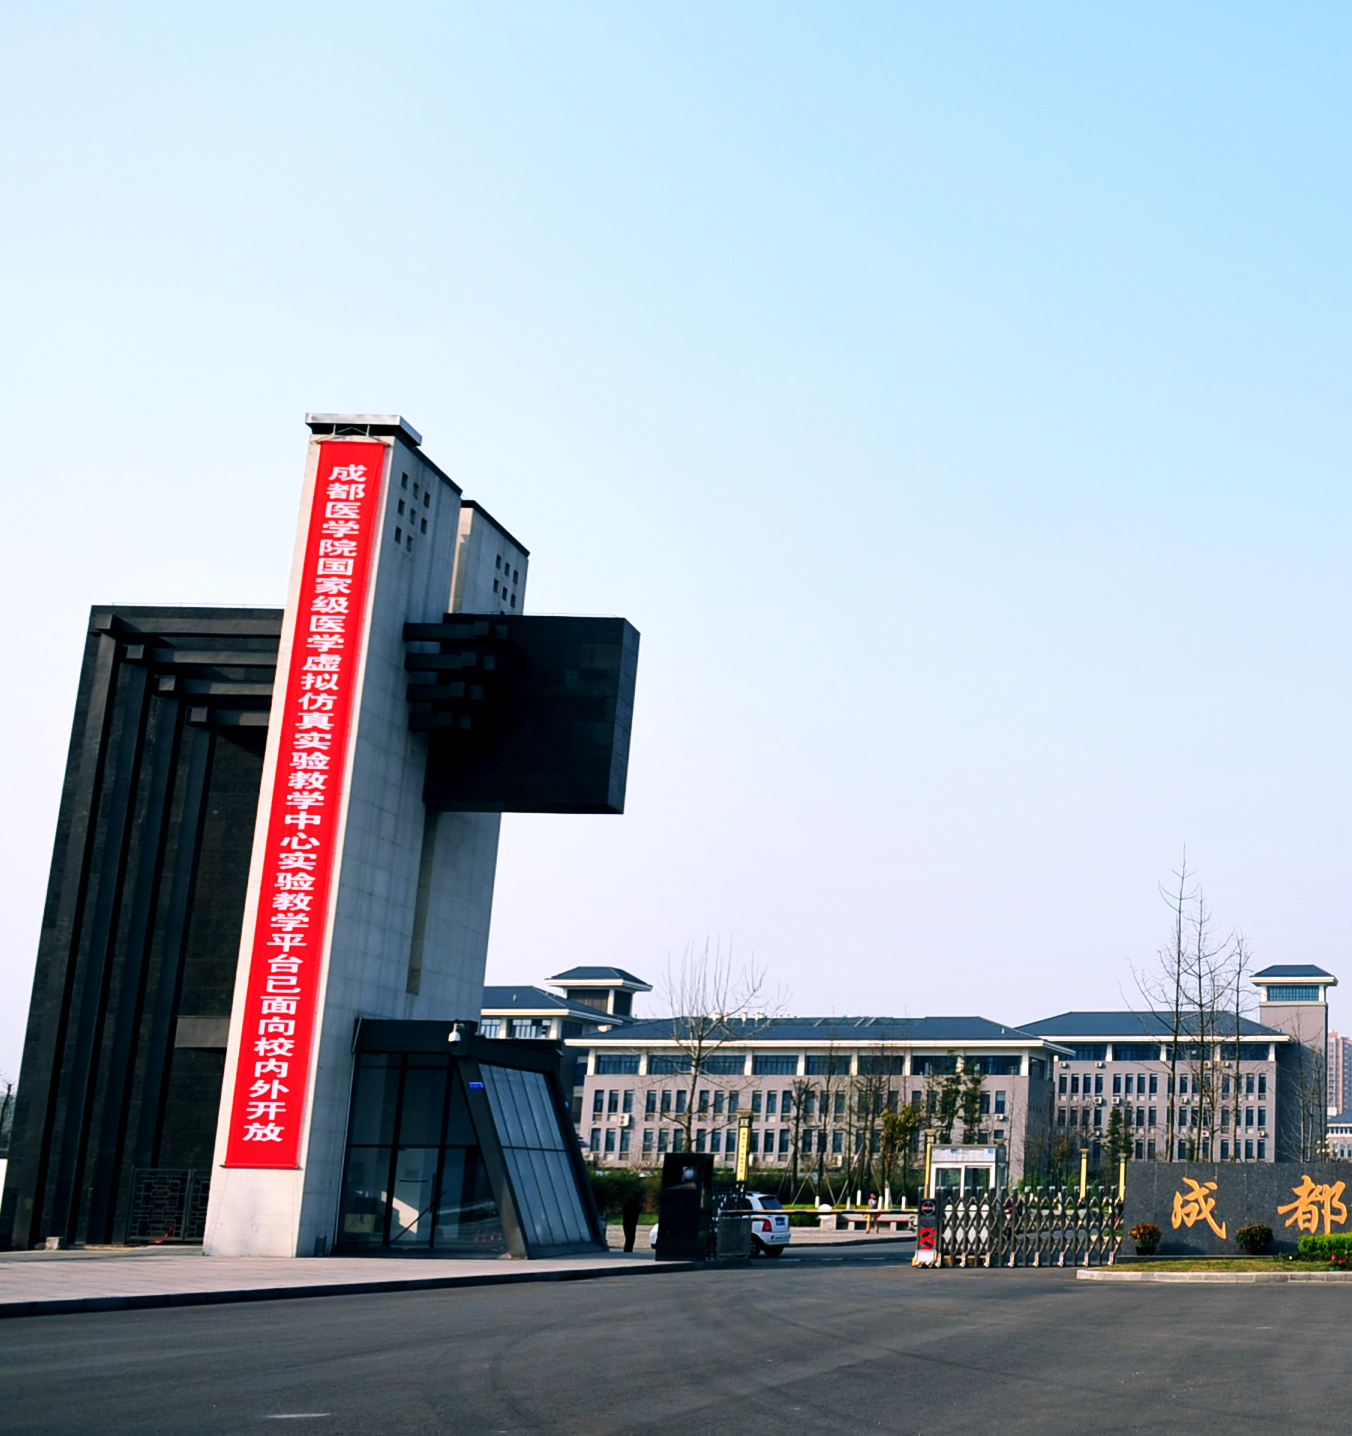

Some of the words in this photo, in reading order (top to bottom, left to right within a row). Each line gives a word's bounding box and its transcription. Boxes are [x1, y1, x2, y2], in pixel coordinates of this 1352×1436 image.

[243, 464, 367, 1141] 成都医学院国家级医学虚拟仿真实验教学中心实验教学平台已面向校内外开放
